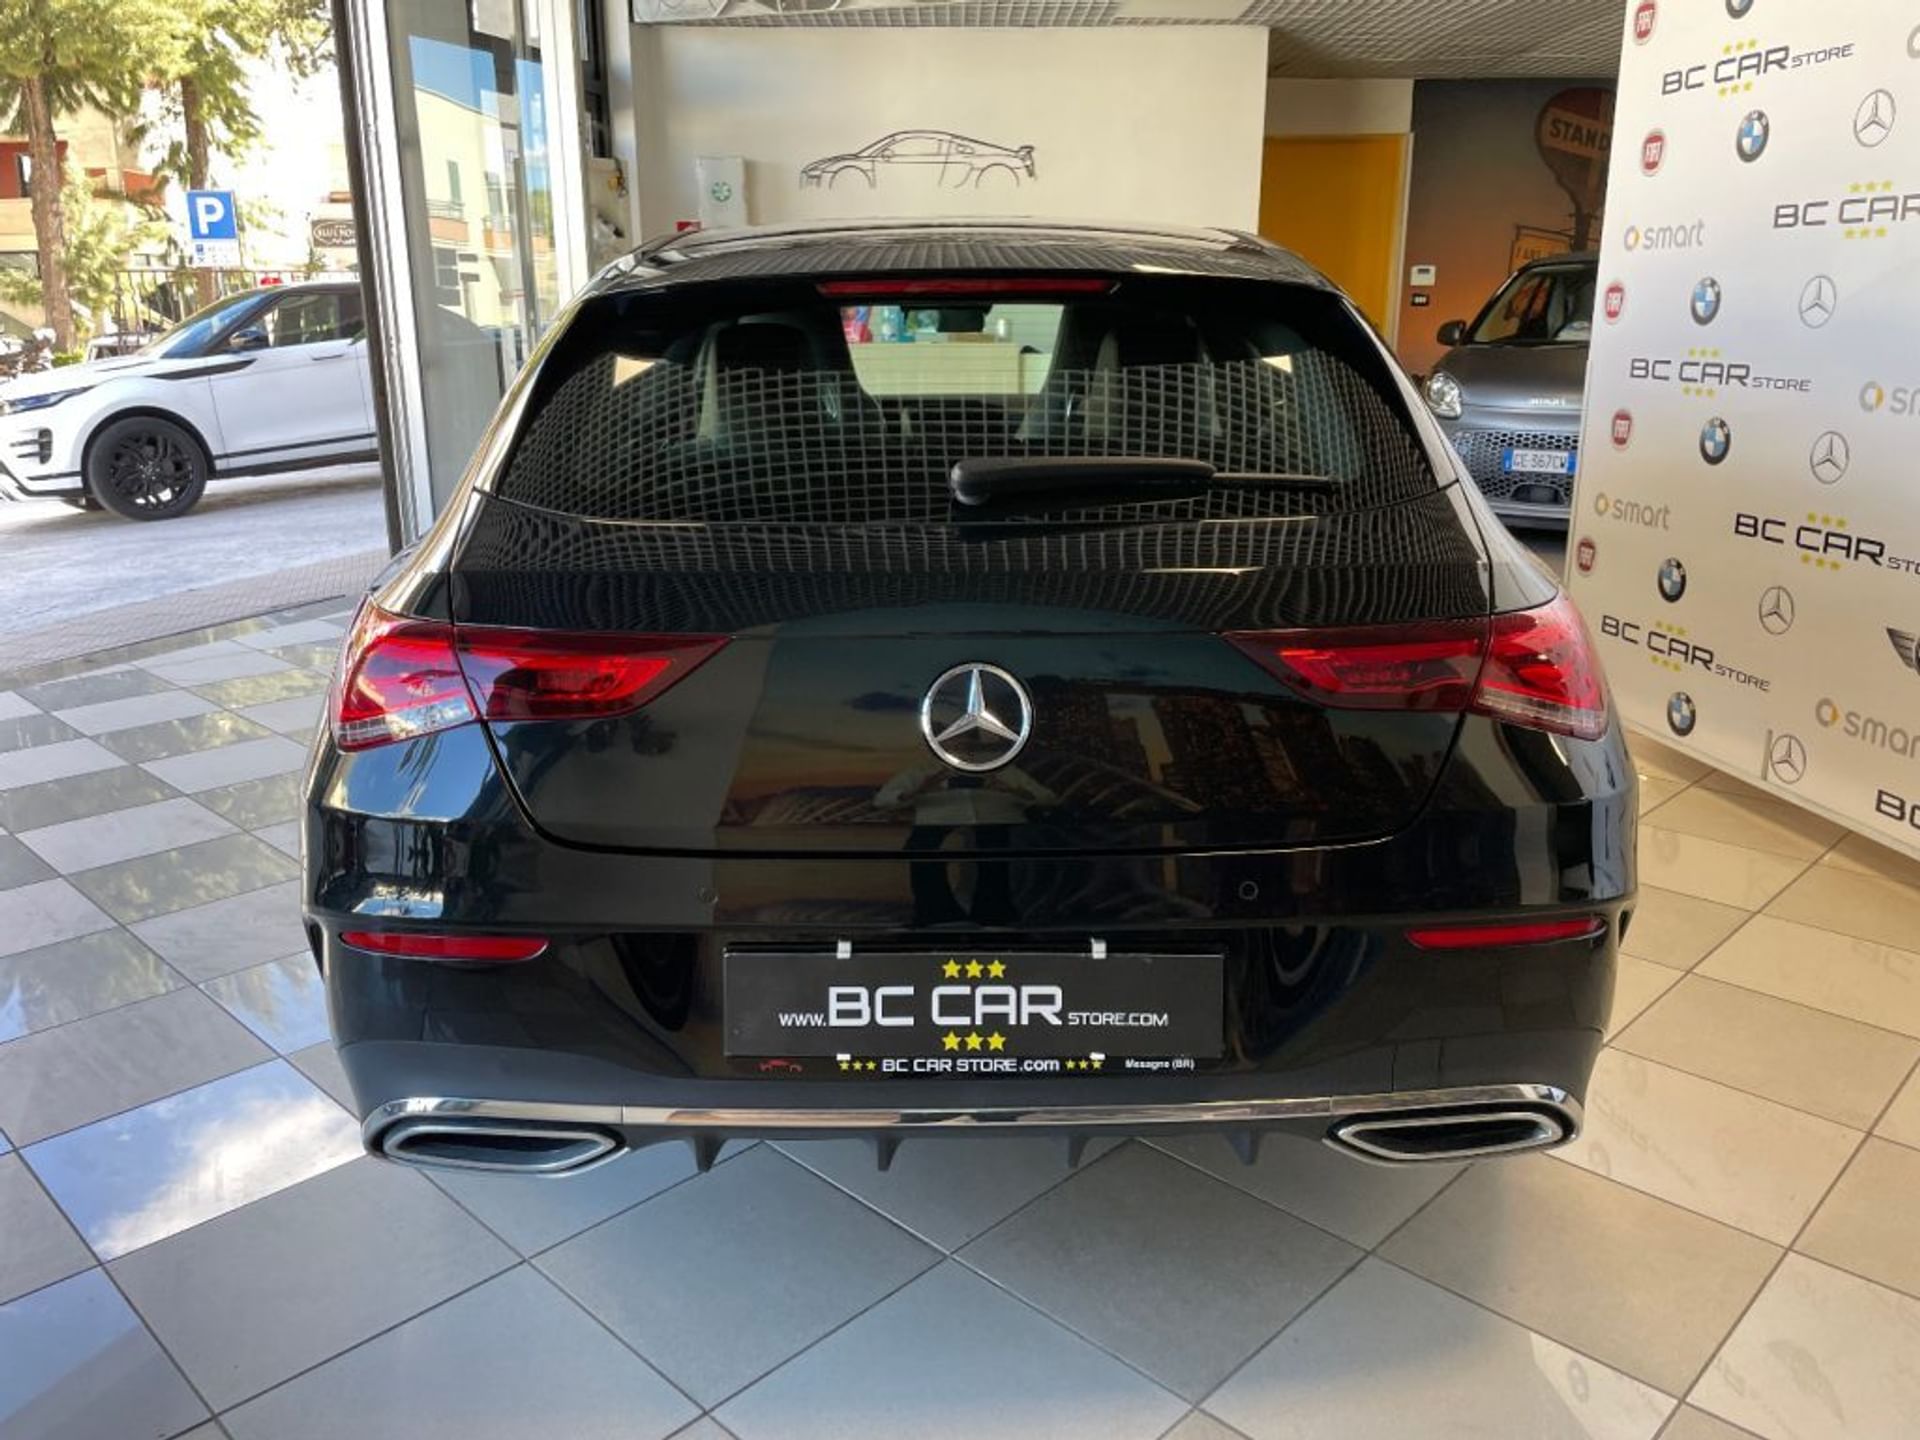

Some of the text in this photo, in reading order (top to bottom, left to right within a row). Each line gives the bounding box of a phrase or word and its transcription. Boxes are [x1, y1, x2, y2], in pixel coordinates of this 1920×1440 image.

[1661, 43, 1854, 95] BC CAR STORE
[196, 197, 224, 234] P
[1773, 201, 1829, 228] BC
[1643, 219, 1704, 250] smart
[1629, 358, 1811, 392] BC CAR STORE
[1612, 498, 1670, 531] smart
[1734, 513, 1786, 544] BC
[1795, 525, 1885, 567] CAR
[1601, 614, 1770, 693] BC CAR STORE
[931, 985, 1063, 1026] CAR
[881, 1058, 909, 1072] BC
[912, 1058, 951, 1072] CAR
